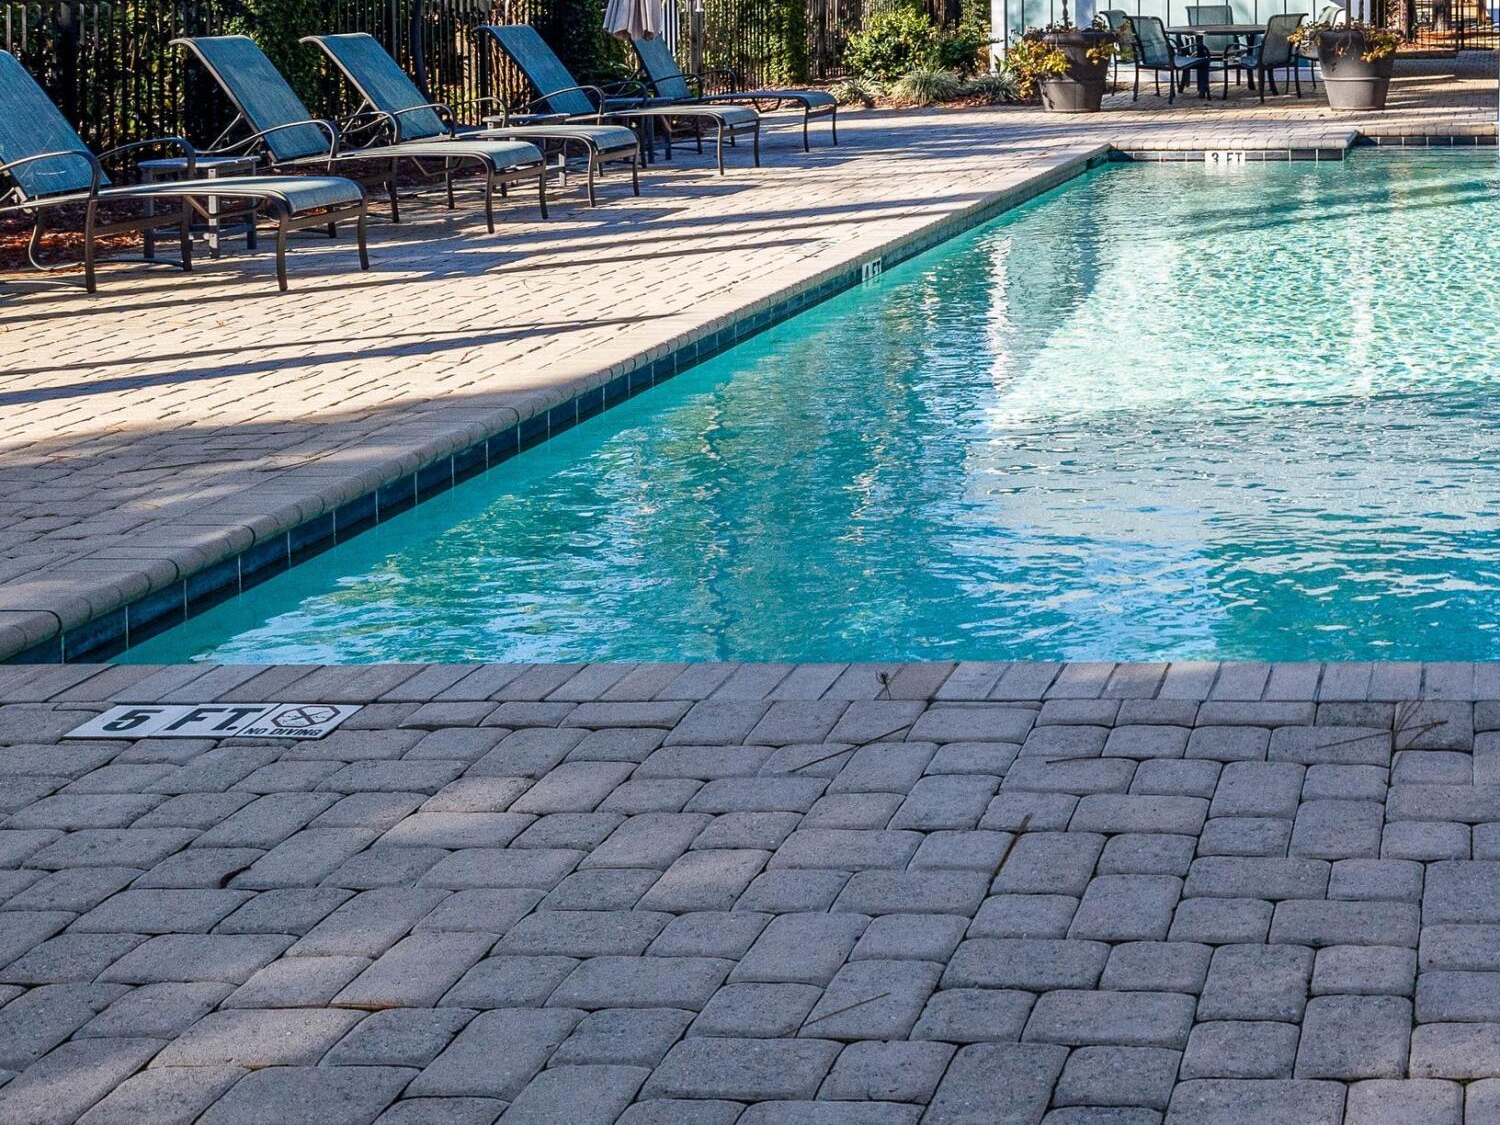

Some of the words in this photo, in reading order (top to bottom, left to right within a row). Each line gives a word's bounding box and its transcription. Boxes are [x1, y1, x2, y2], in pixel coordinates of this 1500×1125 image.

[1211, 152, 1219, 163] 3
[1226, 152, 1243, 163] FT
[102, 709, 165, 732] 5
[163, 707, 267, 732] FT.
[243, 727, 267, 736] NO
[268, 727, 324, 737] DIVING
